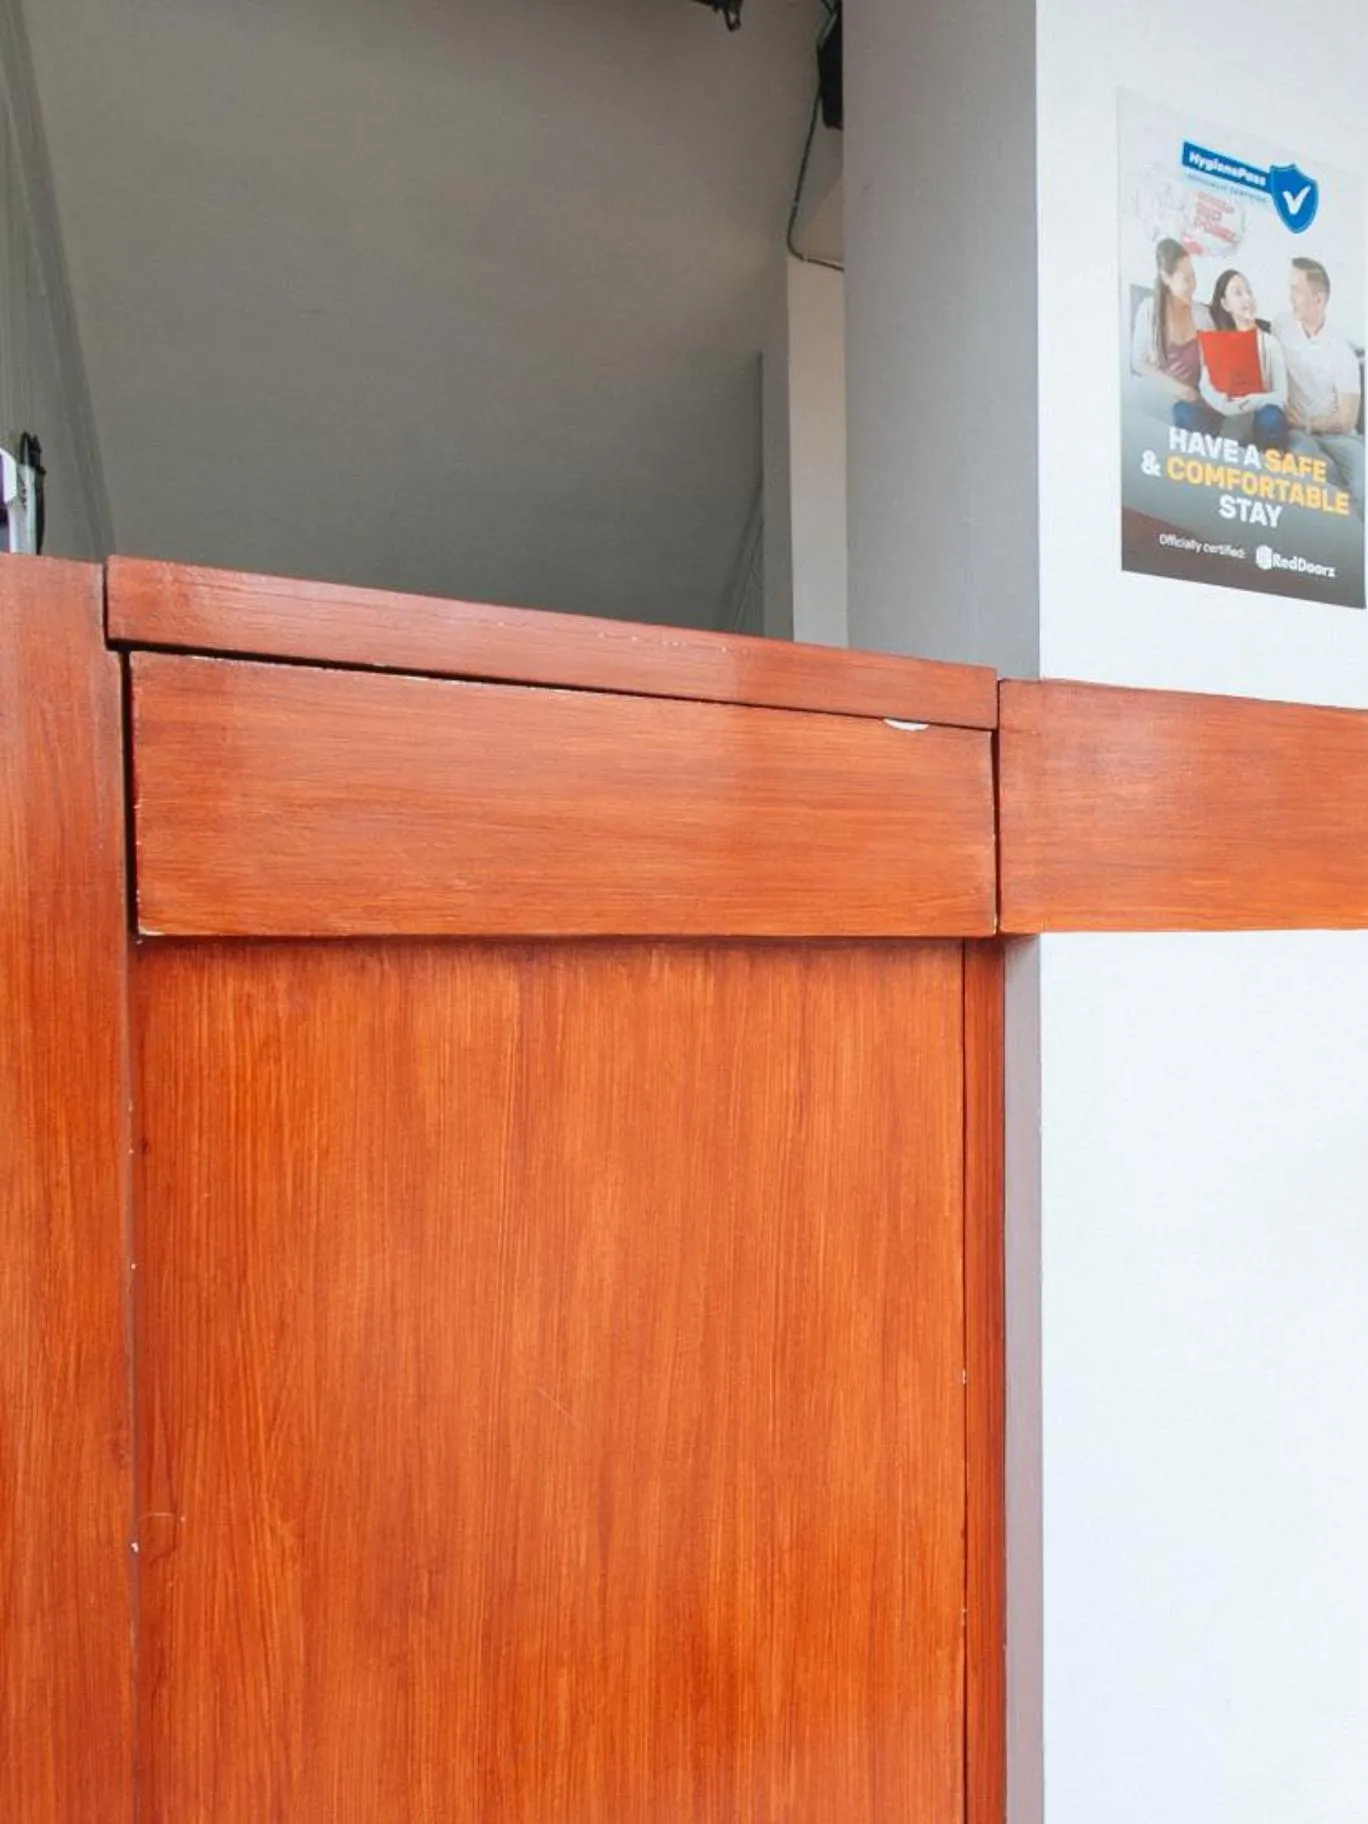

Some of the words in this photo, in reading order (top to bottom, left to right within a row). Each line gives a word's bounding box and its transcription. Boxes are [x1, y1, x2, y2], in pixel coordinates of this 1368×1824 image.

[1169, 426, 1239, 464] HAVE
[1243, 444, 1261, 470] A
[1264, 448, 1328, 484] SAFE
[1141, 449, 1161, 477] &
[1166, 456, 1350, 515] COMFORTABLE
[1219, 495, 1283, 528] STAY
[1159, 533, 1202, 554] Officially
[1272, 552, 1337, 578] RedDoorz
